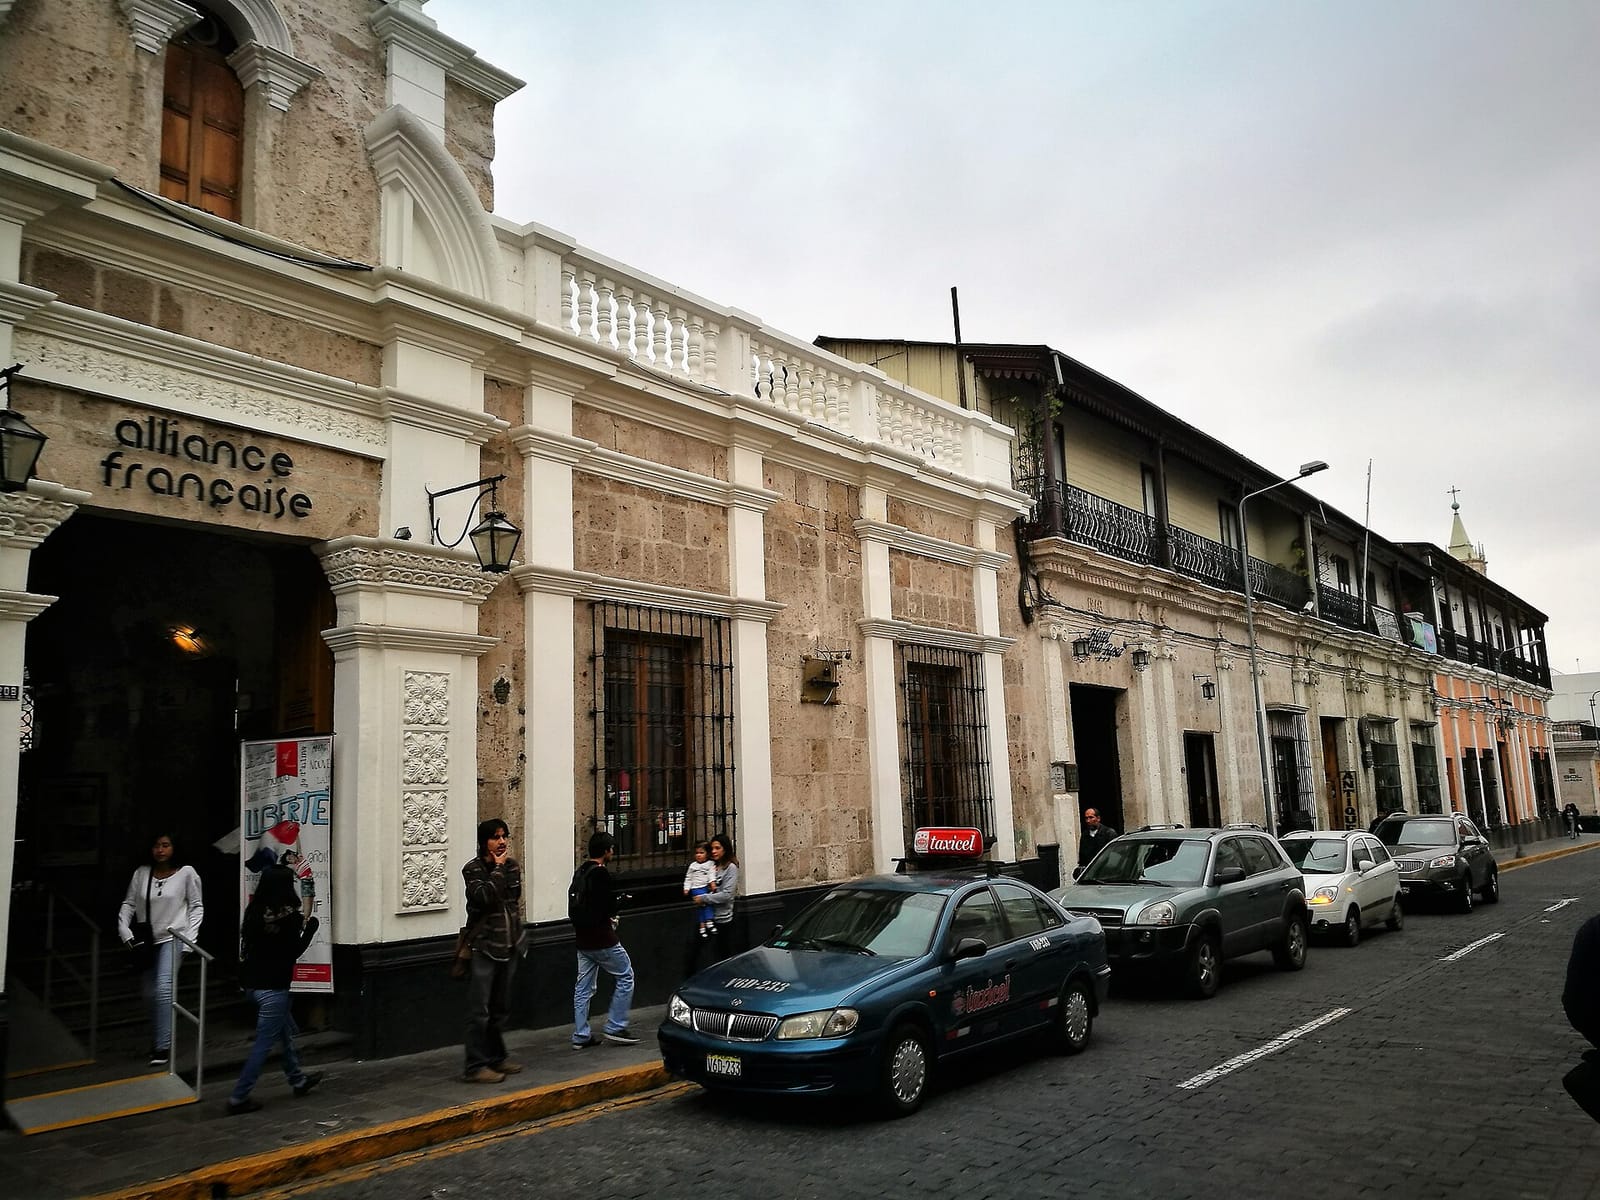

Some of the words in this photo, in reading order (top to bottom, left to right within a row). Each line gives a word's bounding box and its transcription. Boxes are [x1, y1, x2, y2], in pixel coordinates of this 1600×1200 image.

[115, 415, 294, 477] alliance
[101, 451, 313, 519] française
[930, 834, 976, 851] taxicel
[724, 977, 791, 993] V6D-233
